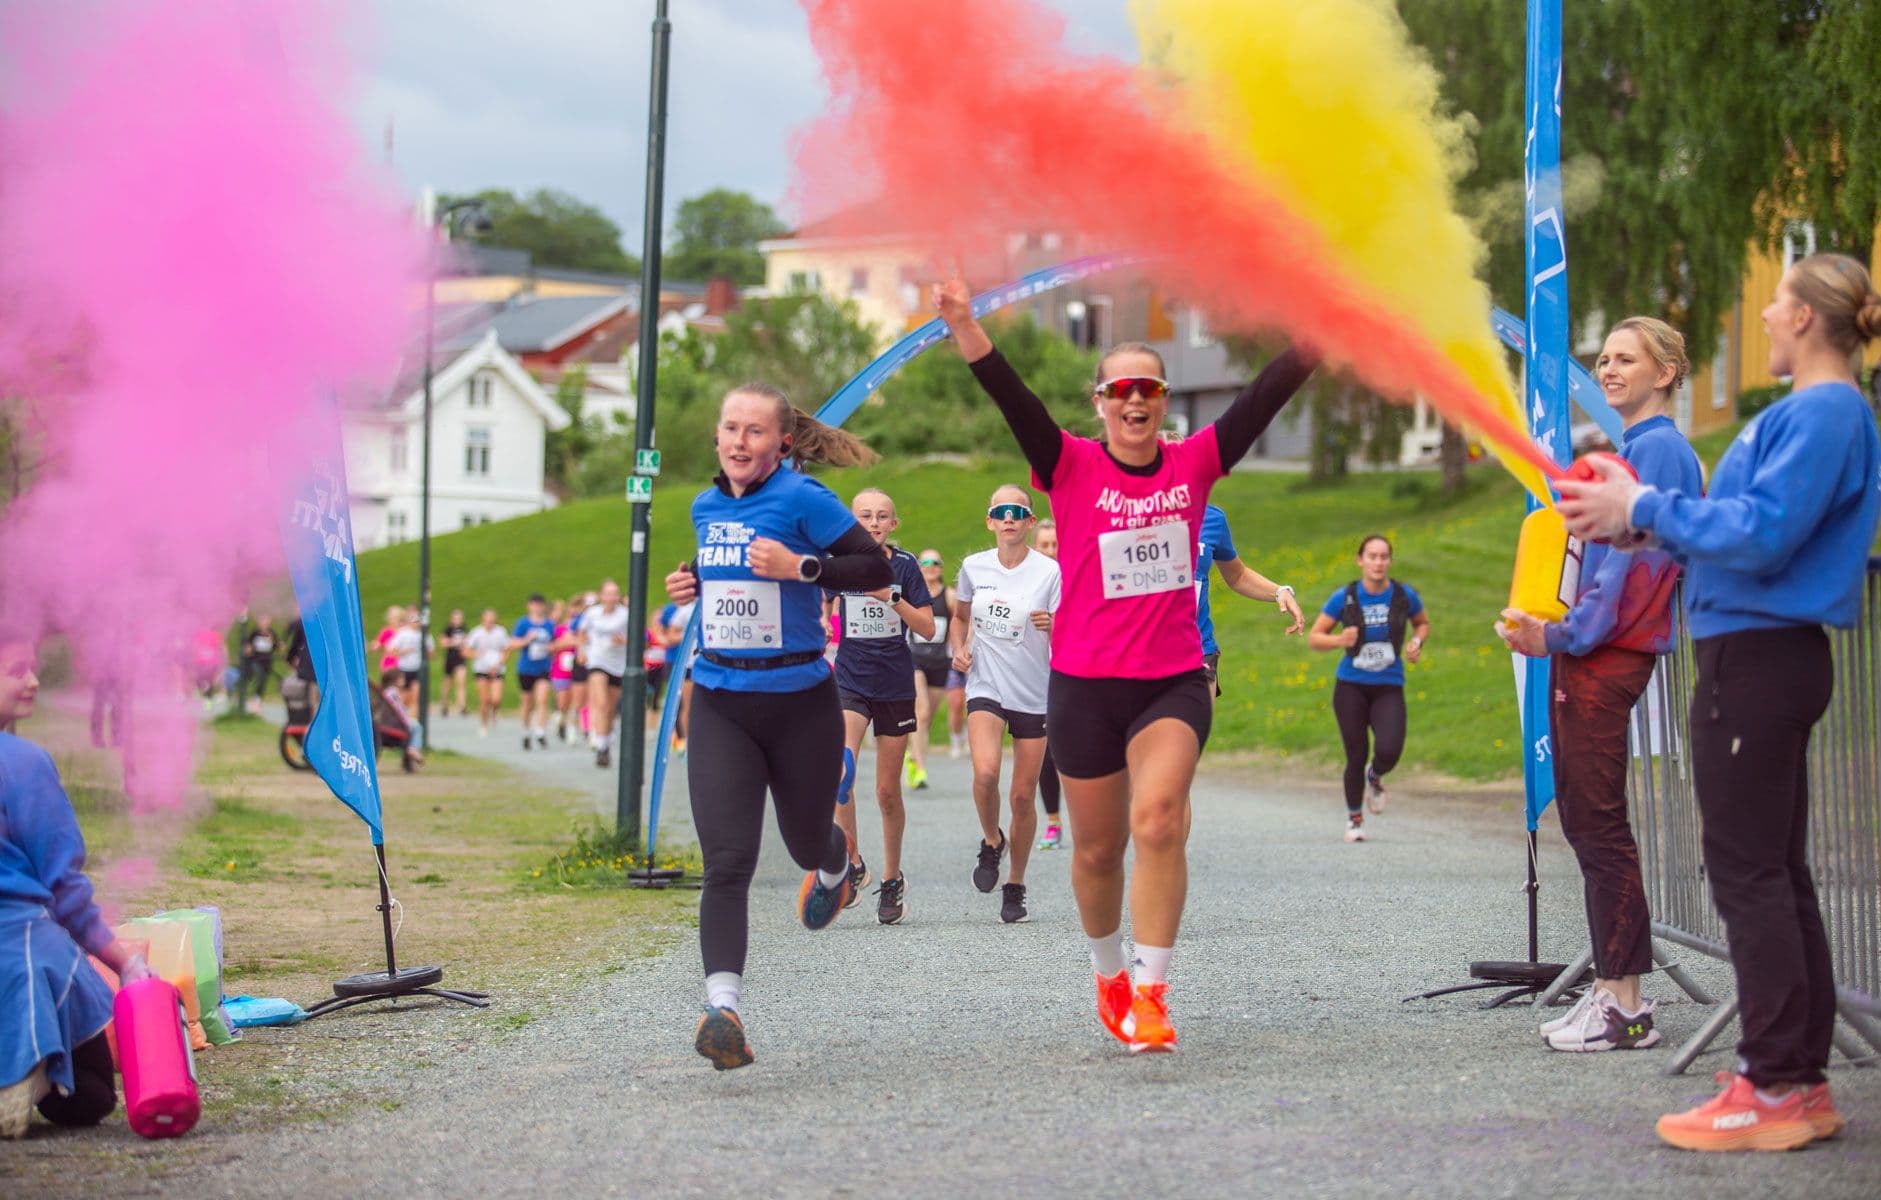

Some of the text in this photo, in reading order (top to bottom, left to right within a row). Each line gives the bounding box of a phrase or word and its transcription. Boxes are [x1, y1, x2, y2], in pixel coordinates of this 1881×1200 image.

[698, 545, 742, 567] TEAM
[1124, 541, 1170, 563] 1601
[1133, 566, 1168, 589] DNB
[716, 599, 759, 616] 2000
[862, 606, 884, 618] 153
[988, 604, 1011, 619] 152
[720, 621, 753, 645] DNB
[863, 621, 884, 635] DNB
[985, 620, 1007, 634] DNB
[1712, 1109, 1759, 1131] HOKA
